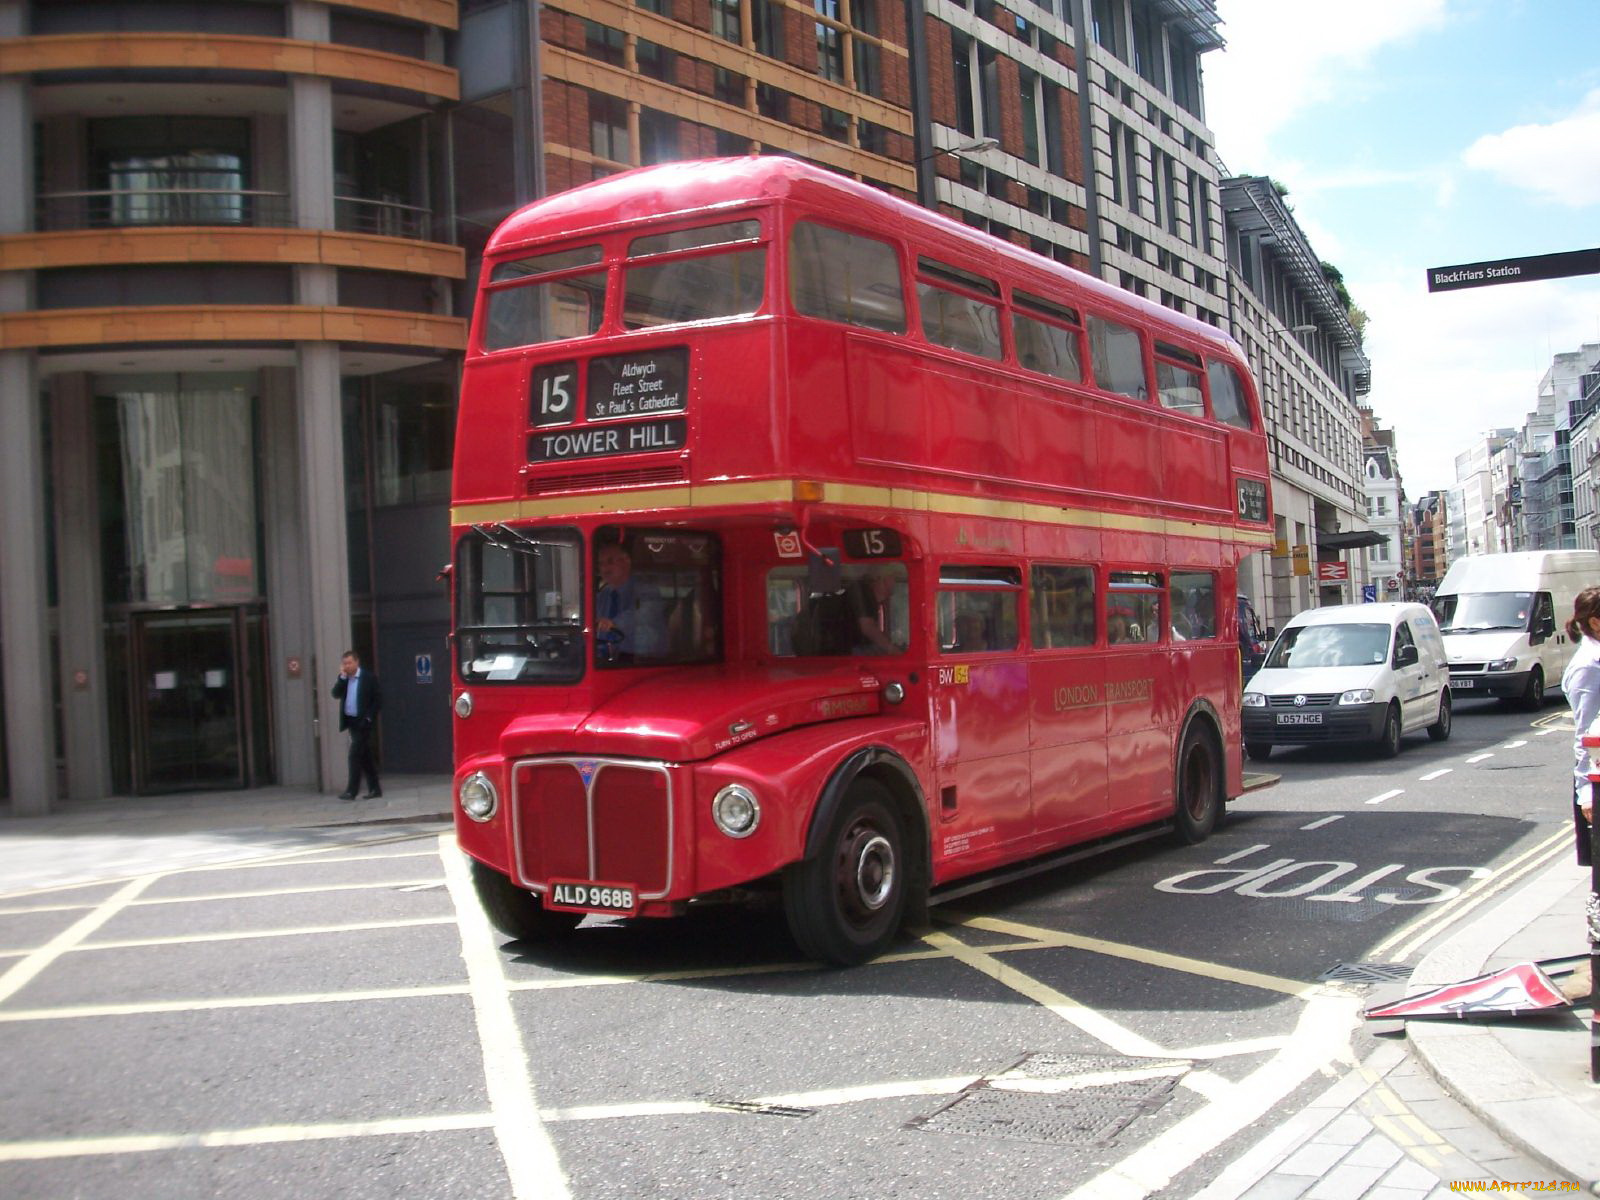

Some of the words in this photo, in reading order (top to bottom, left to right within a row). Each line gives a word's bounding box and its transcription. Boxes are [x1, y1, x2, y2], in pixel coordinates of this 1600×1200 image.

[1434, 270, 1484, 284] Blackfriars
[1486, 265, 1521, 278] Station
[621, 360, 656, 378] Aldwych
[541, 374, 571, 415] 15
[612, 382, 634, 397] Fleet
[638, 378, 663, 393] Street
[595, 402, 605, 416] St
[608, 399, 635, 414] Paul's
[639, 393, 679, 411] Cathedral
[542, 430, 619, 457] TOWER
[629, 424, 676, 449] HILL
[862, 530, 885, 555] 15
[939, 669, 954, 685] BW
[1054, 684, 1098, 712] LONDON
[1104, 678, 1155, 702] TRANSPORT
[1302, 714, 1321, 723] HGE
[715, 739, 731, 750] TURN
[731, 736, 740, 744] TO
[1153, 857, 1493, 905] STOP
[553, 885, 587, 904] ALD
[589, 888, 634, 908] 968B
